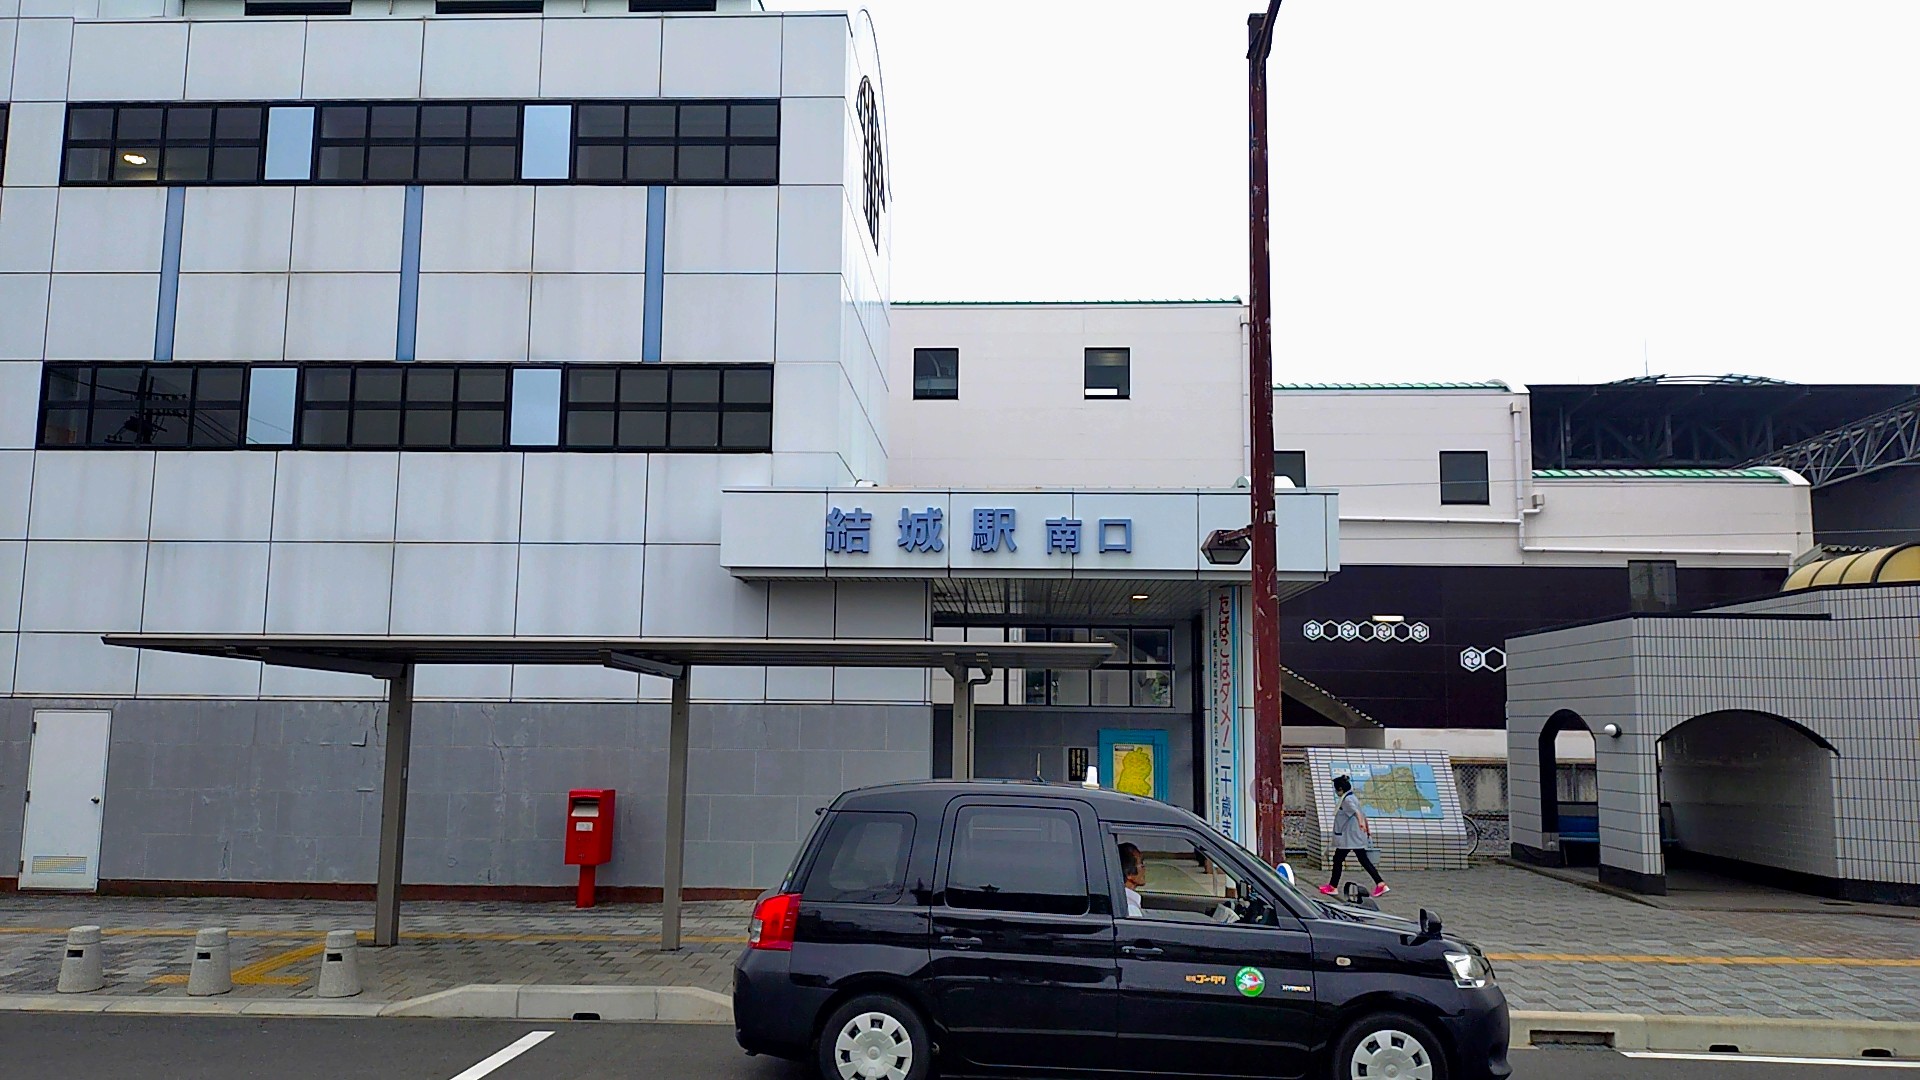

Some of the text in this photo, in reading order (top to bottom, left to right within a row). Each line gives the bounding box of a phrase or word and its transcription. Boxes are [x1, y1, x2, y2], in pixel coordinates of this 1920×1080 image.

[826, 507, 1132, 554] 結城駅南口
